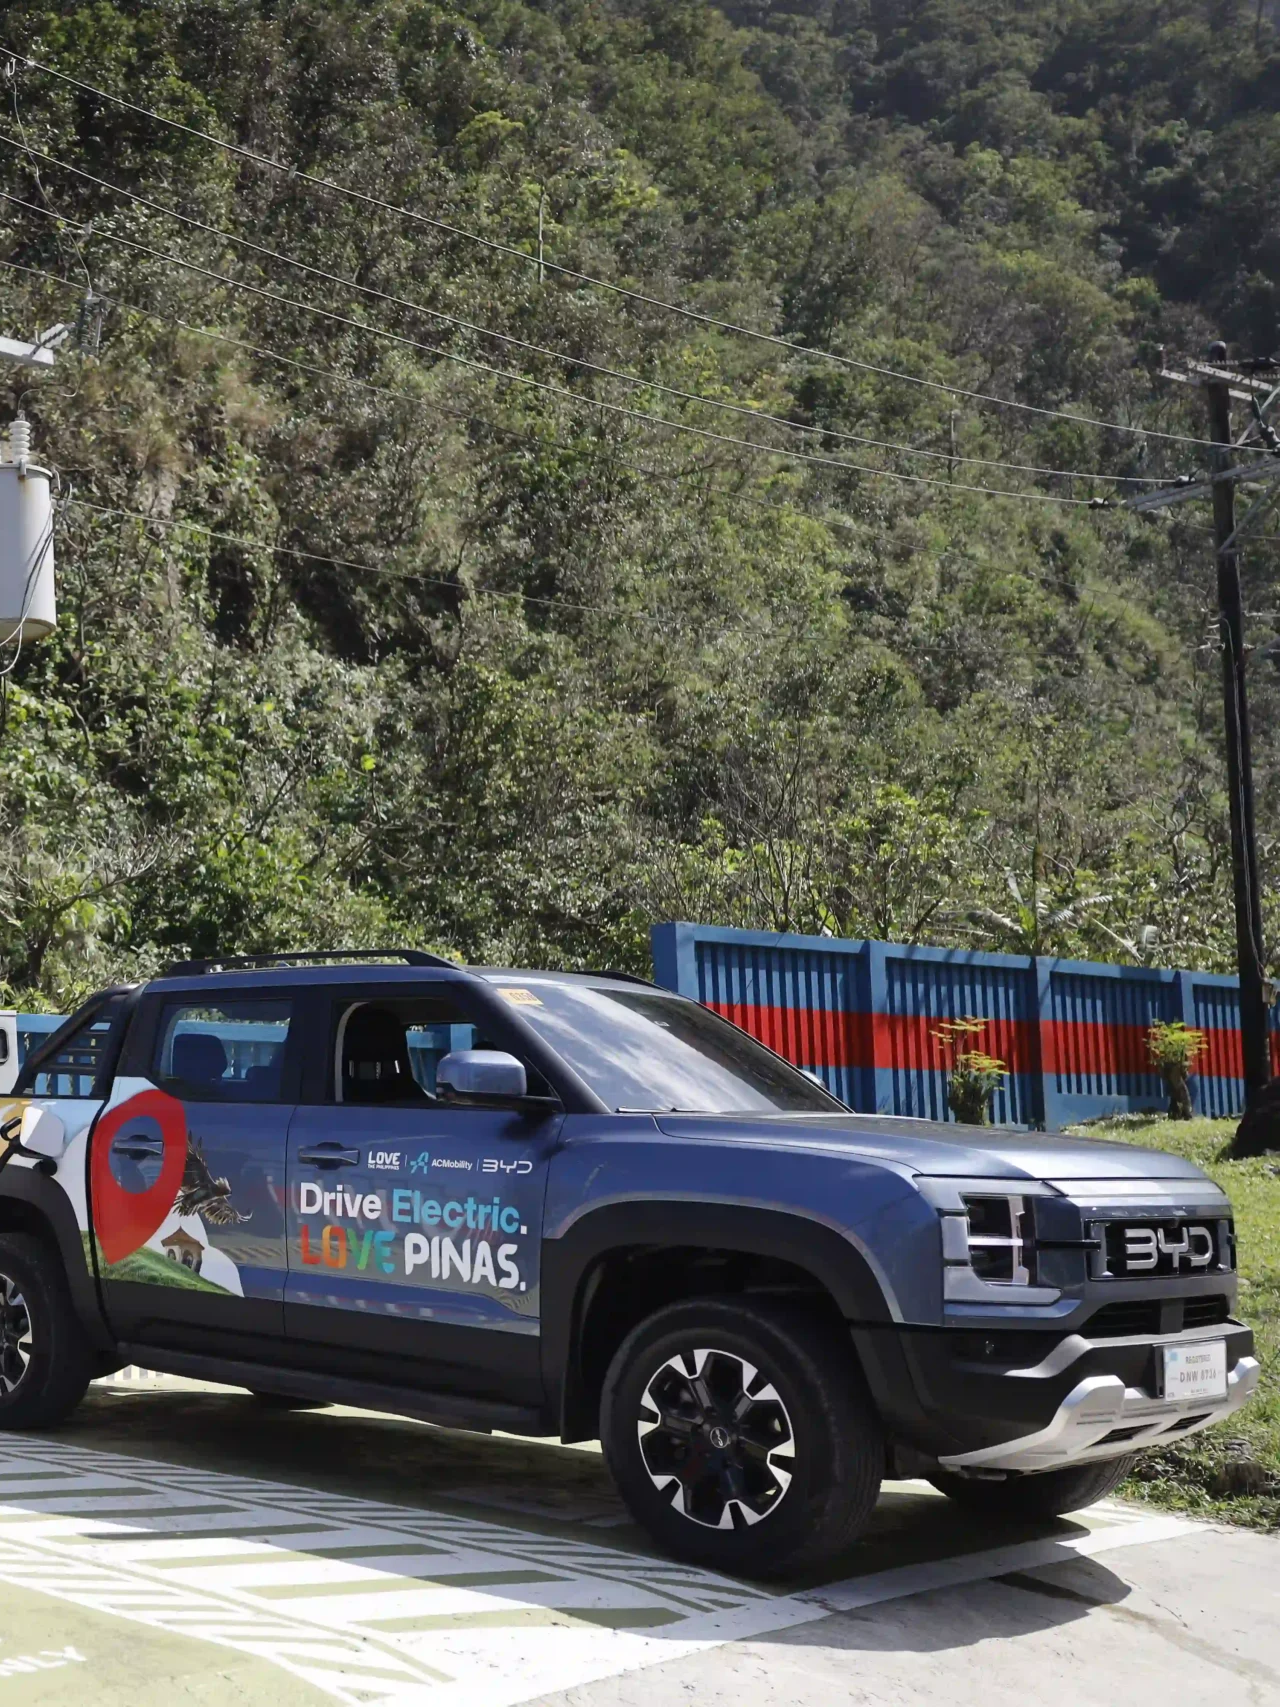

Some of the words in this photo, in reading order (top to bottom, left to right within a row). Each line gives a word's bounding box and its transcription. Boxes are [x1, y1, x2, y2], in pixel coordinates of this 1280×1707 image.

[368, 1150, 401, 1165] LOVE
[431, 1158, 473, 1171] ACMobility
[482, 1158, 533, 1174] BYD
[300, 1182, 382, 1220] Drive
[392, 1188, 528, 1235] Electric.
[300, 1224, 396, 1274] LOVE
[404, 1232, 527, 1292] PINAS.
[1125, 1226, 1214, 1270] BYD
